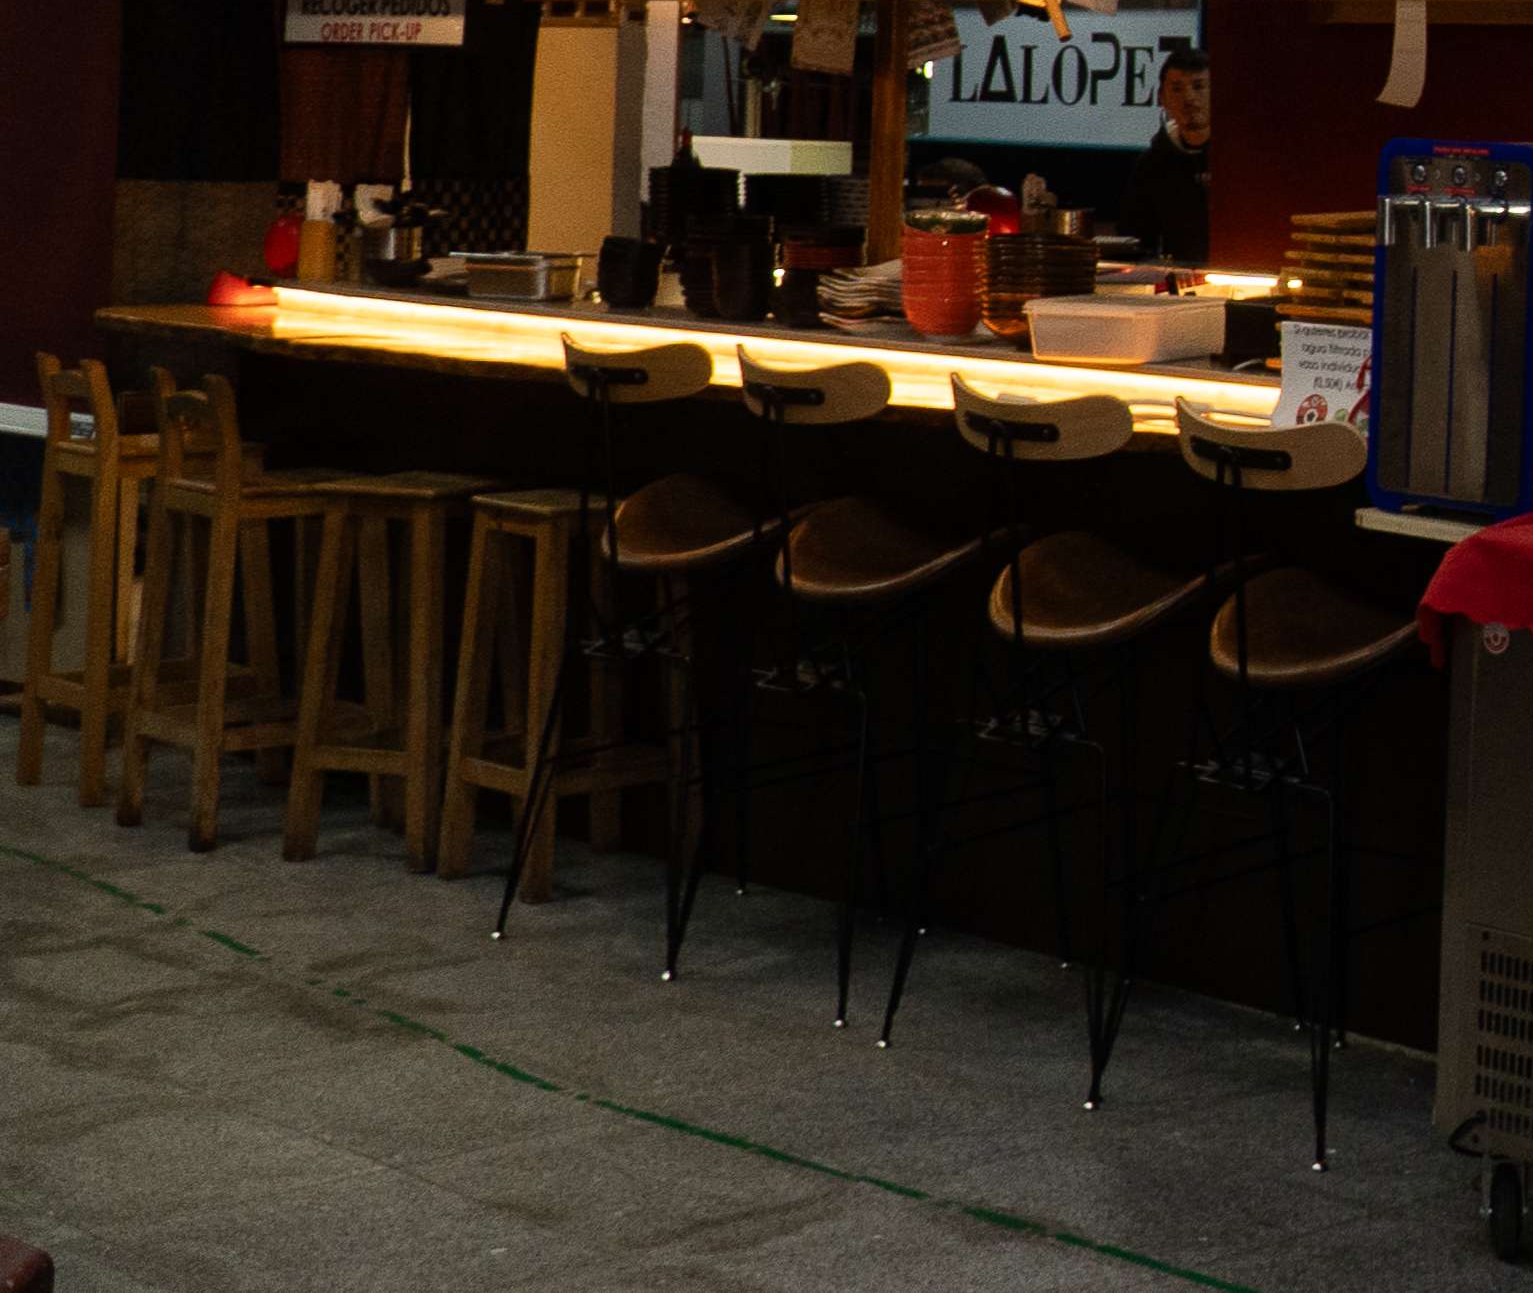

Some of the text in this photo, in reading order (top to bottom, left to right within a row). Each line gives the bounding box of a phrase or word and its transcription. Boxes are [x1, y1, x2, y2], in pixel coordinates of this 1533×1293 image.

[321, 22, 423, 42] ORDER PICK-UP
[949, 32, 1191, 108] LALOPE
